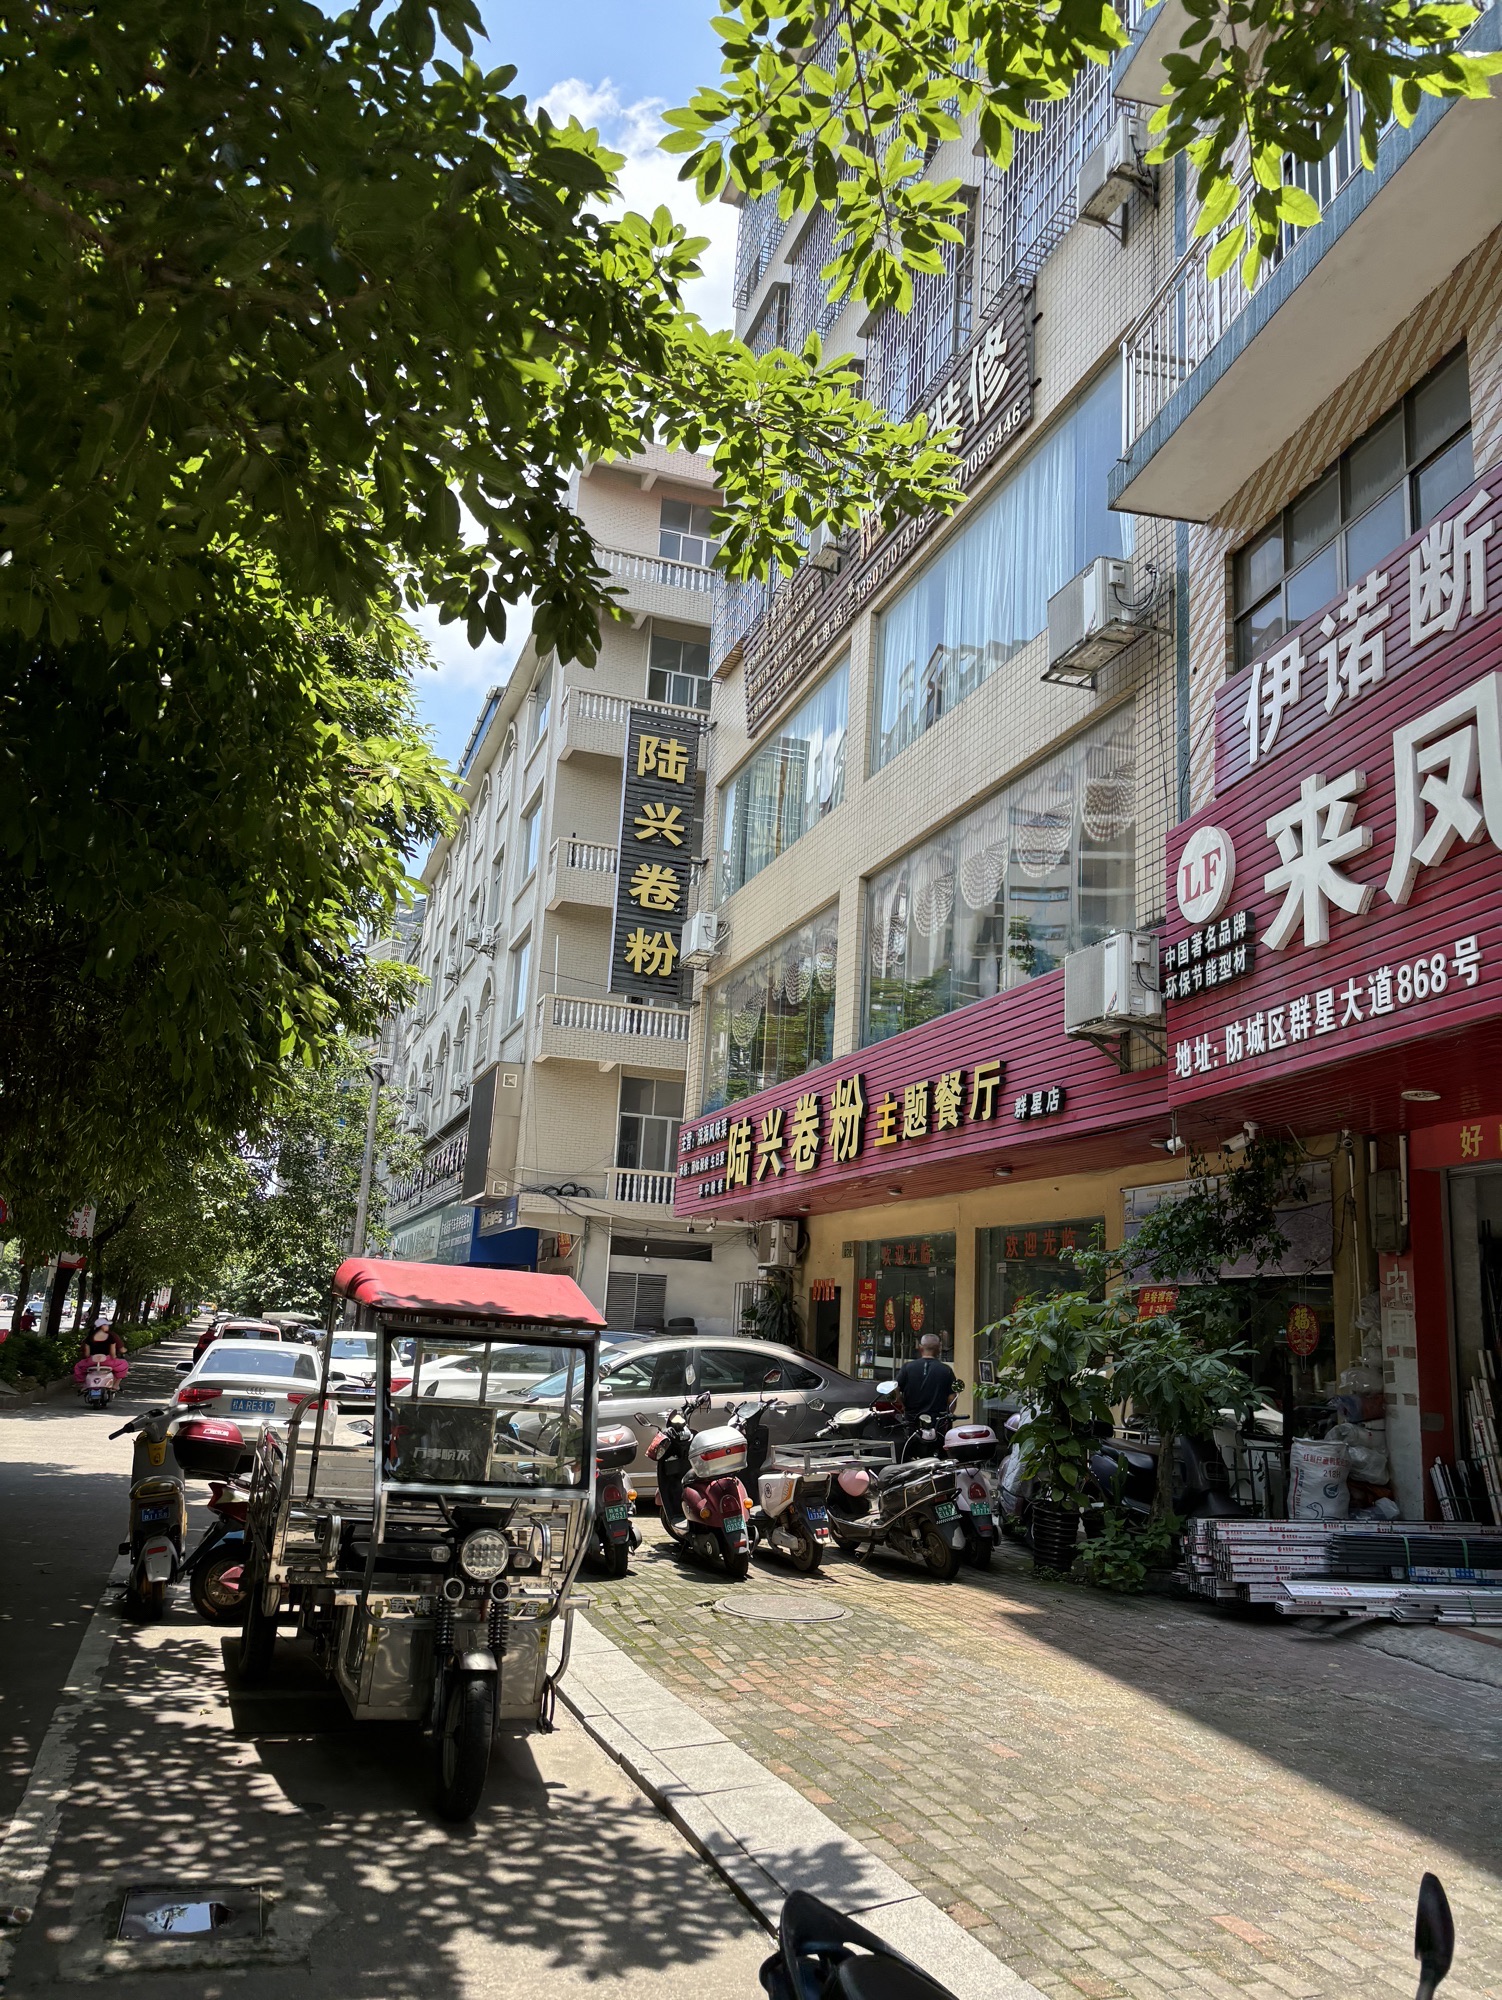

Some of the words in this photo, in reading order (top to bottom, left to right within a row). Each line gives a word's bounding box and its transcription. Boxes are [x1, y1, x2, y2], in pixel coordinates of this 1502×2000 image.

[1242, 488, 1496, 766] 伊诺断
[624, 734, 690, 978] 陆兴卷粉
[1259, 670, 1502, 951] 来凤
[1182, 847, 1222, 905] LF
[1164, 910, 1248, 971] 中国著名品牌
[1164, 944, 1248, 1000] 环保节能型材
[1175, 934, 1483, 1079] 地址:防城区群星大道868号
[725, 1073, 866, 1190] 陆兴卷粉
[874, 1059, 1006, 1148] 主题餐厅
[1013, 1085, 1062, 1120] 群星店
[881, 1241, 931, 1266] 欢迎光临
[1005, 1226, 1078, 1258] 欢迎光临
